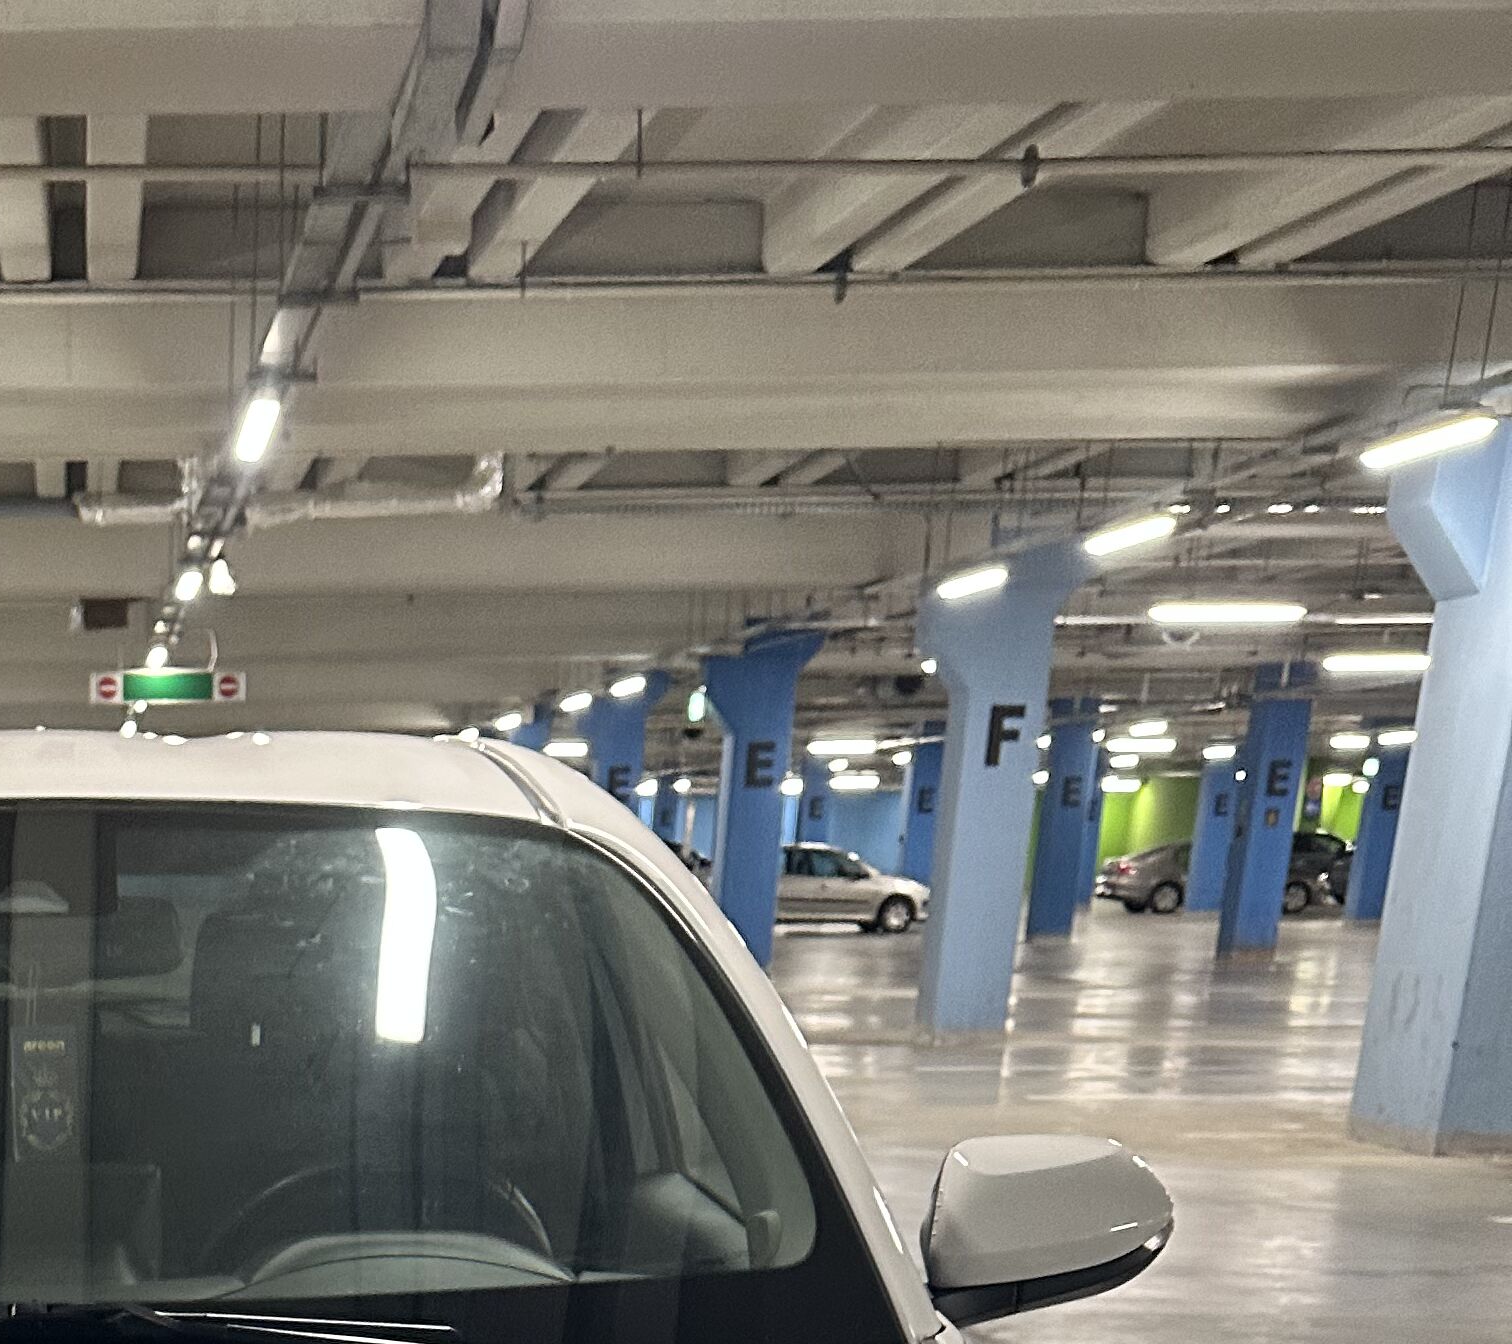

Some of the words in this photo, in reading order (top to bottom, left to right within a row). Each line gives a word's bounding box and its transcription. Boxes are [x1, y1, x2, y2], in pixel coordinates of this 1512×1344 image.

[985, 705, 1026, 766] F
[744, 741, 776, 789] E
[1267, 759, 1292, 797] E
[1062, 775, 1082, 808] E
